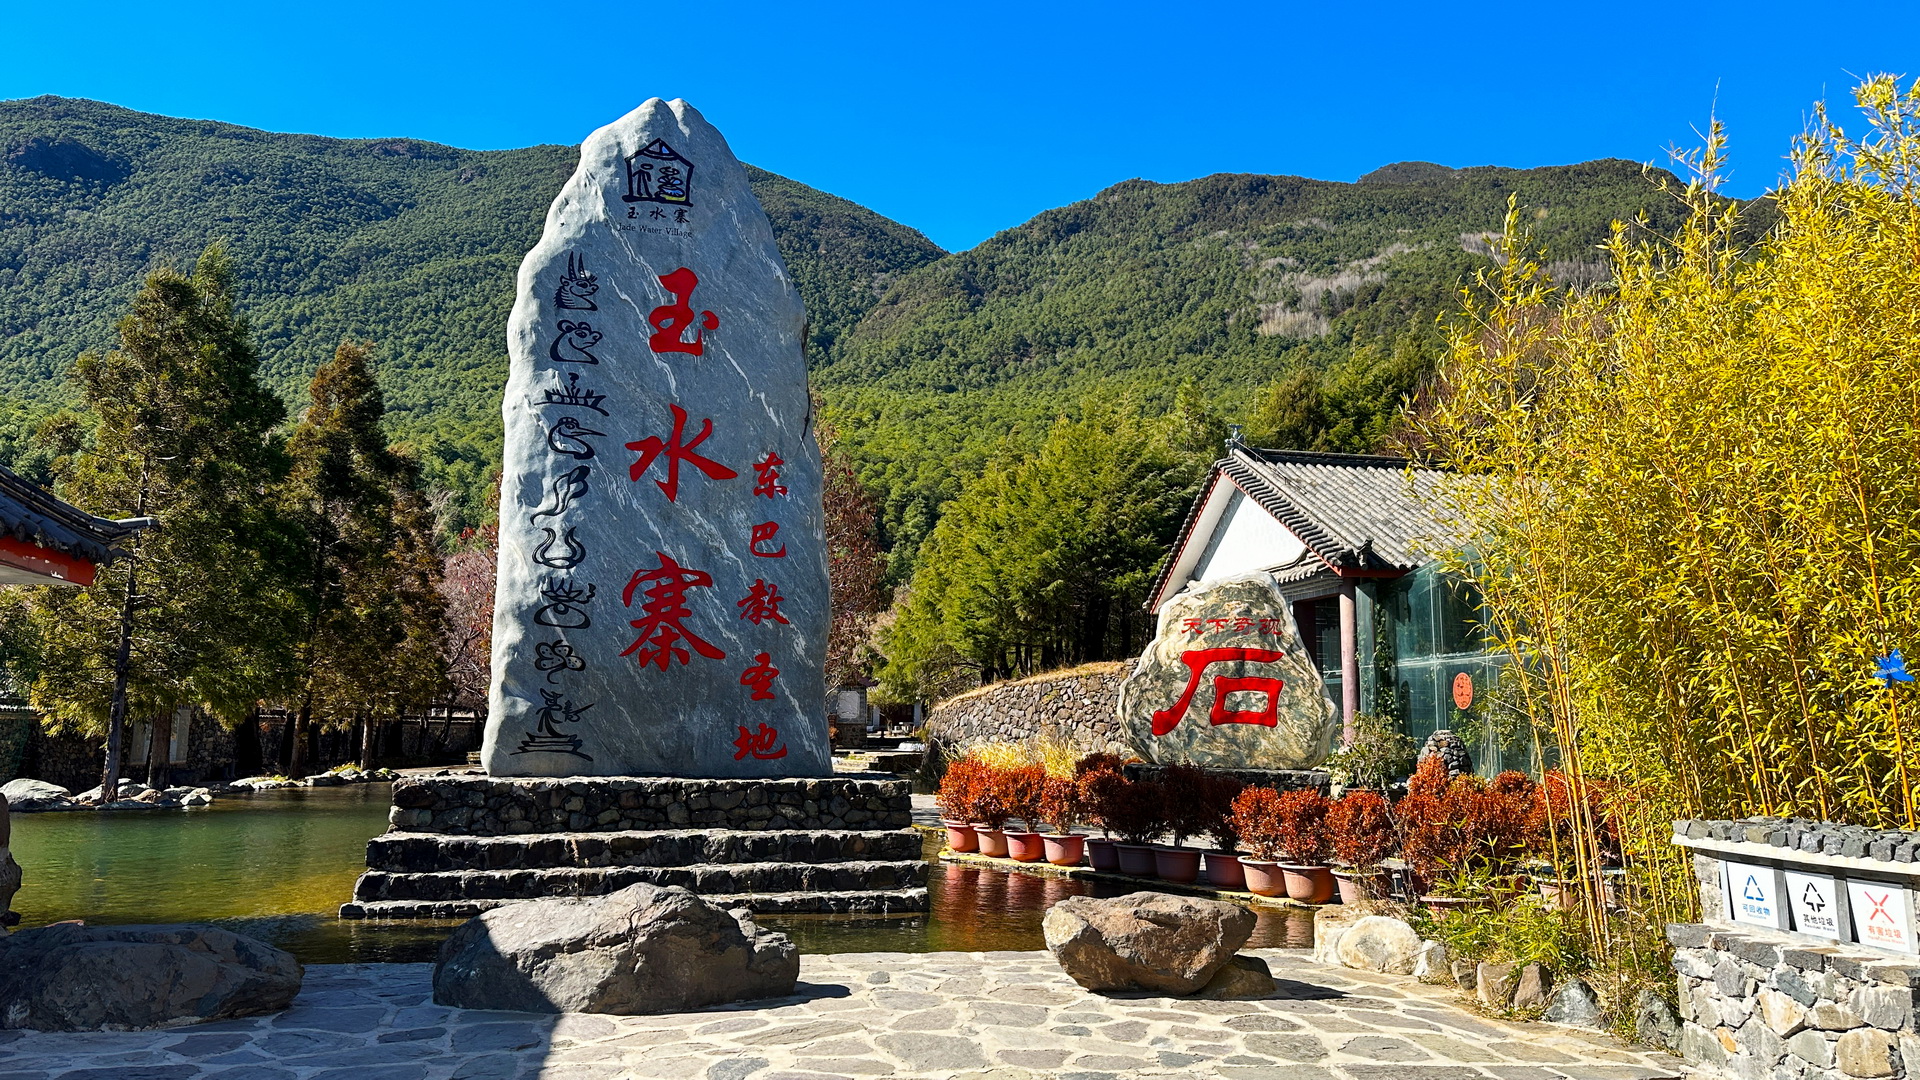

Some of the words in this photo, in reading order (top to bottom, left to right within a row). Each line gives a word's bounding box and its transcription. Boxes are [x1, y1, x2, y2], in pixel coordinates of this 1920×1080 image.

[628, 206, 690, 223] 玉水寨
[618, 222, 636, 232] Jade
[639, 224, 663, 234] Water
[665, 226, 693, 239] Village
[620, 266, 738, 673] 玉水寨
[733, 452, 788, 761] 东巴教圣地
[1181, 617, 1283, 636] 天下奇观
[1151, 646, 1284, 736] 石
[1741, 903, 1770, 917] 可回收物
[1803, 913, 1835, 927] 其他垃圾
